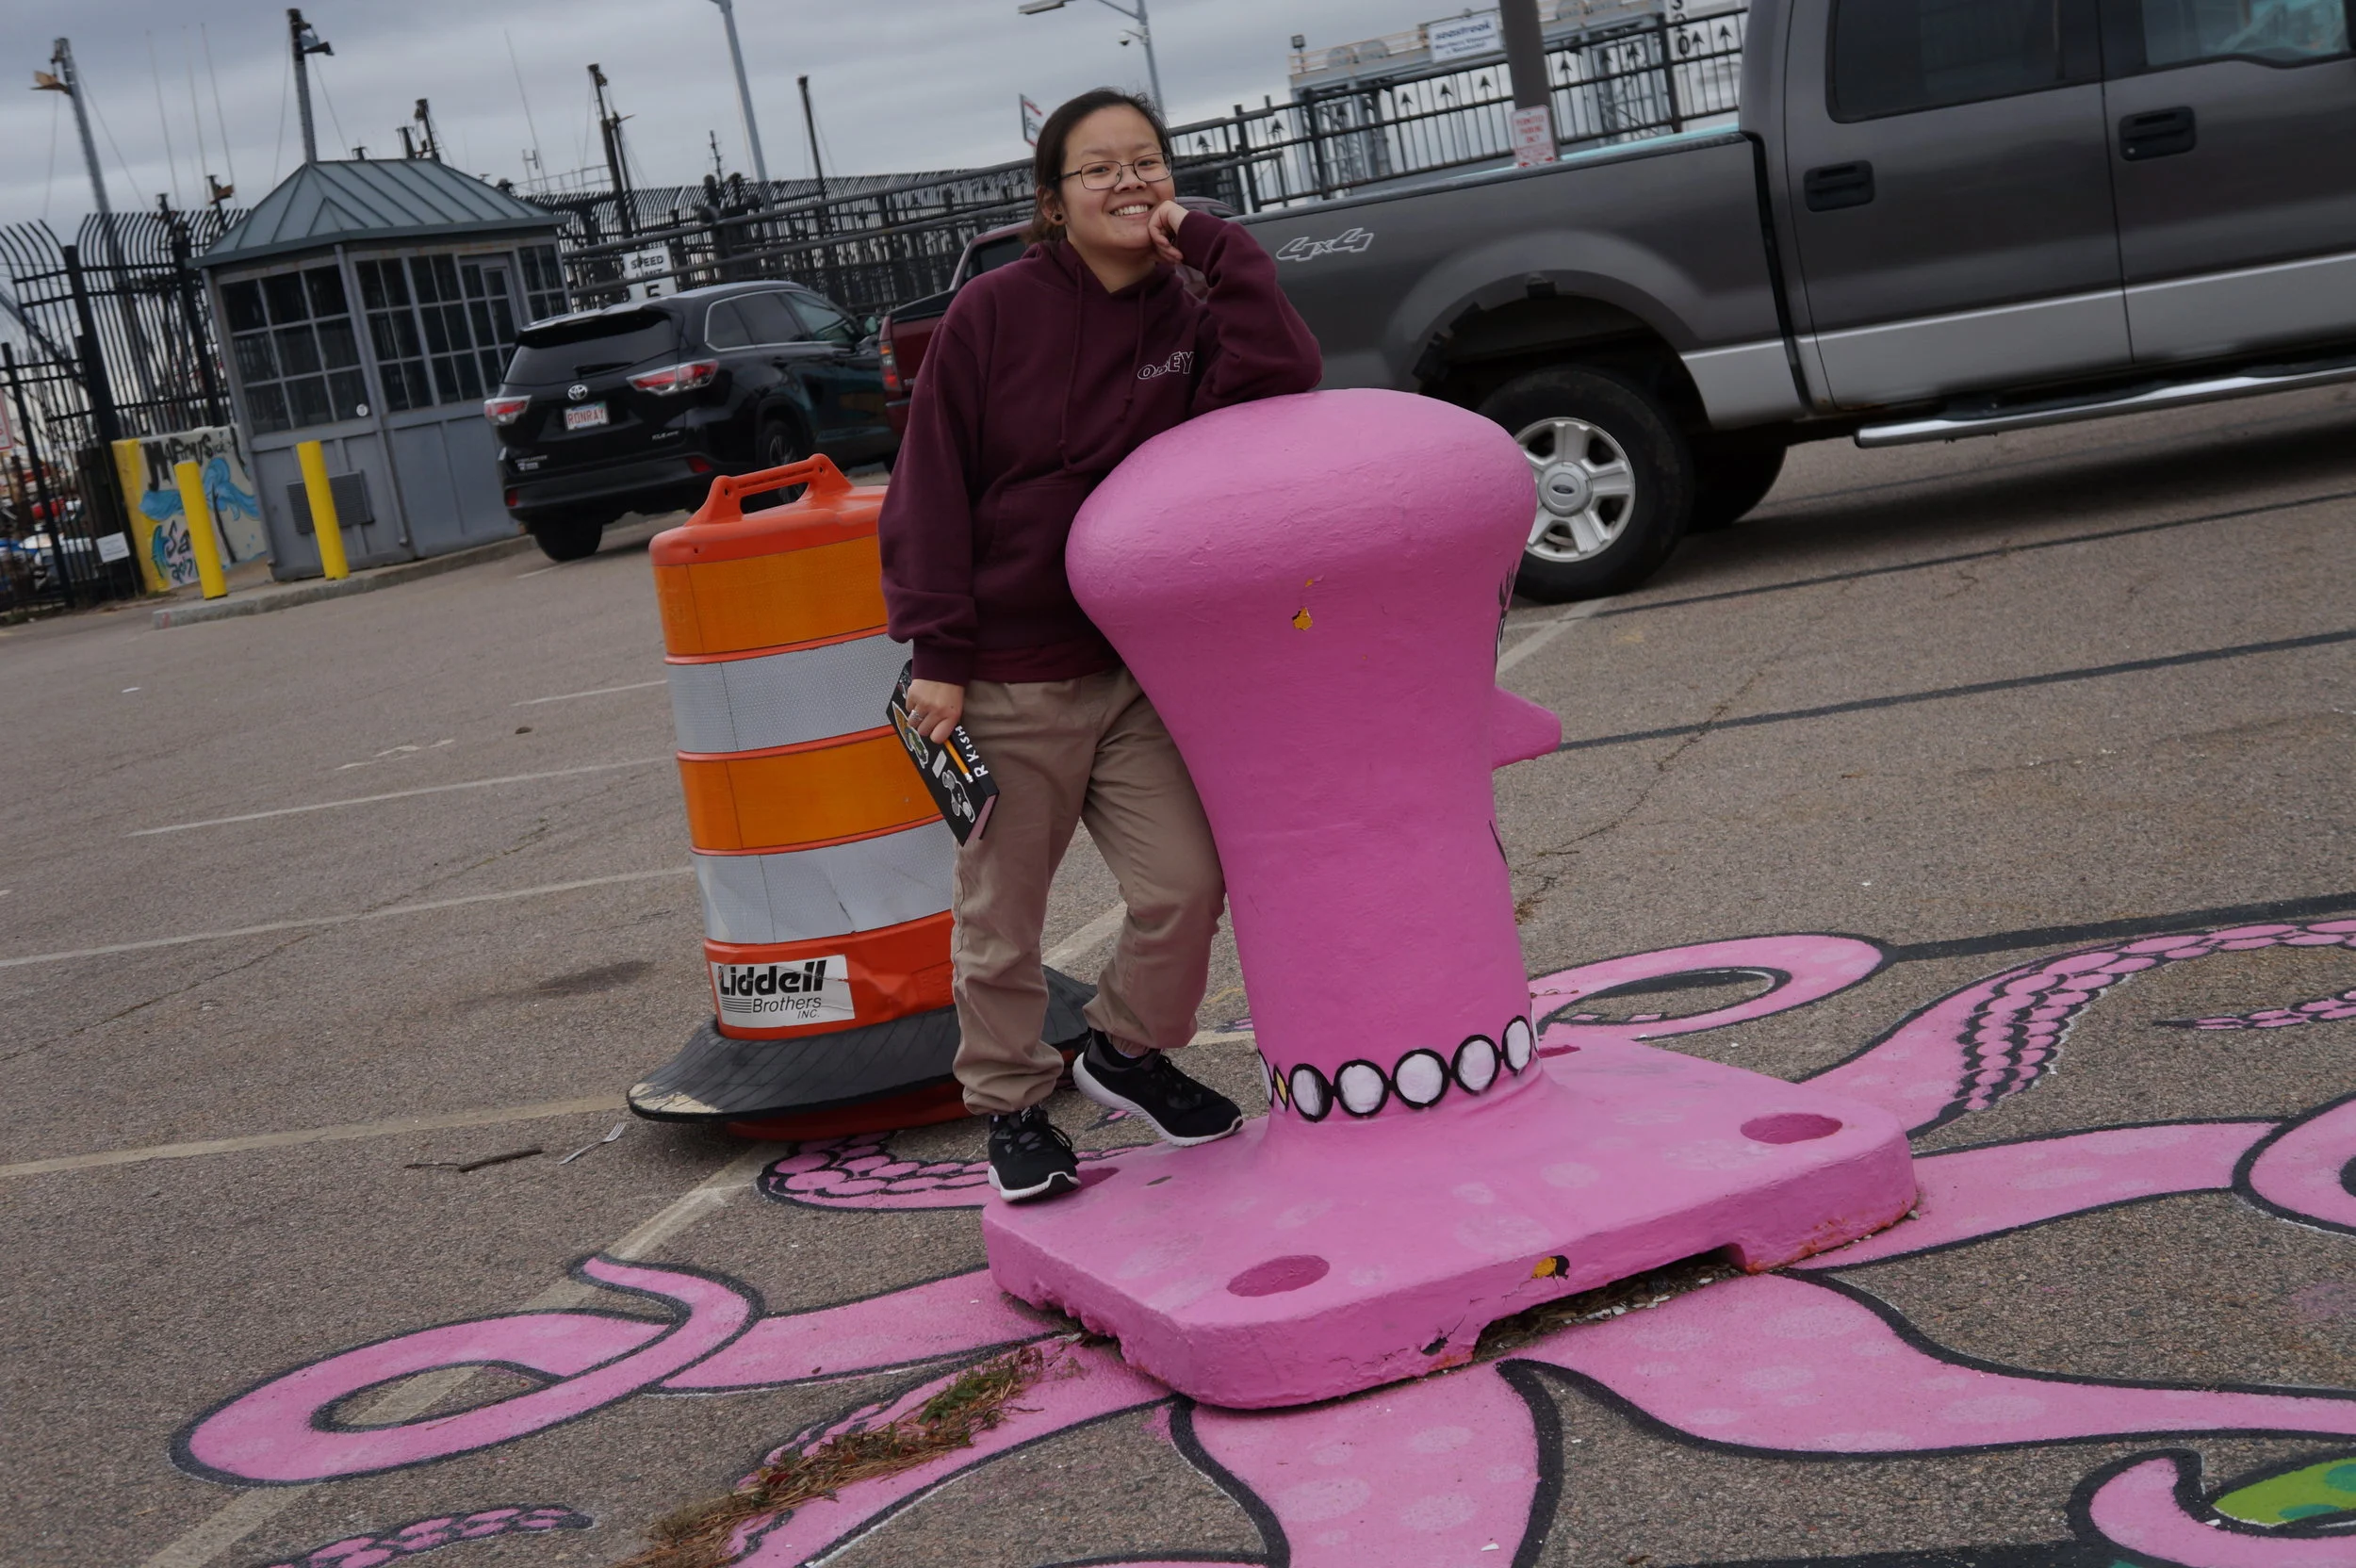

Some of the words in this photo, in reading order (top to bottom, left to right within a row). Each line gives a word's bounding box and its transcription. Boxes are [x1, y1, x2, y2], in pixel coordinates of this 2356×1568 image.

[1276, 227, 1374, 262] 4x4
[567, 408, 605, 425] RONRAY
[718, 959, 827, 996] Liddell
[752, 996, 822, 1013] Brothers
[797, 1010, 820, 1020] INC.
